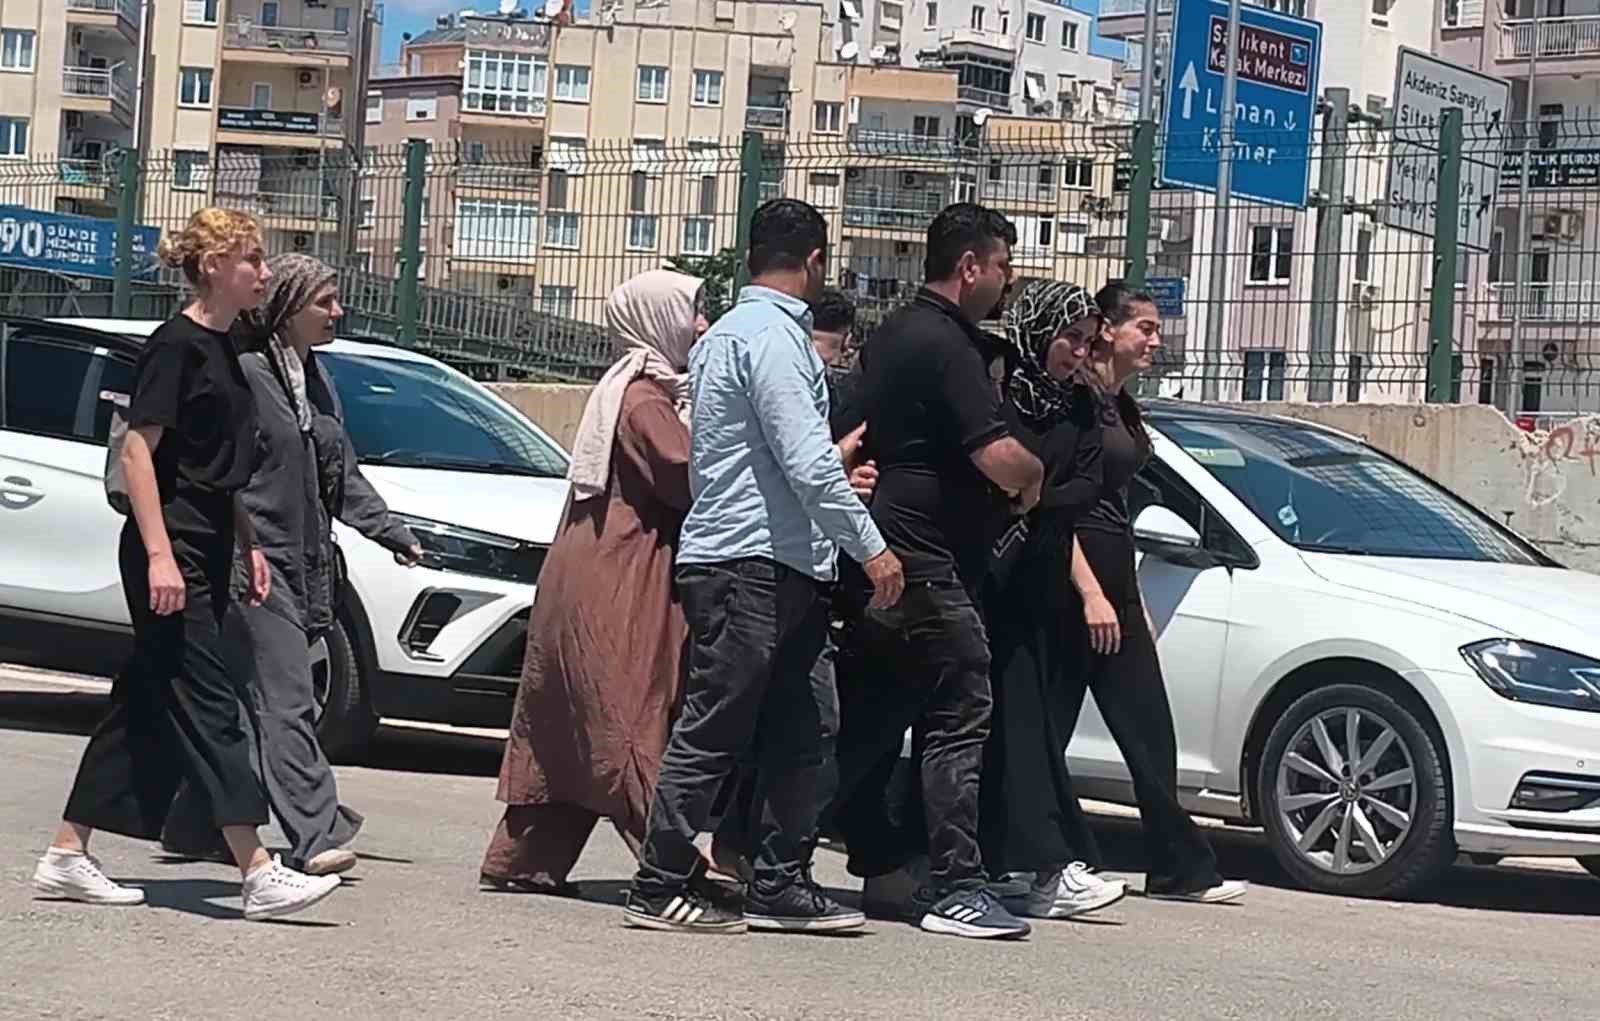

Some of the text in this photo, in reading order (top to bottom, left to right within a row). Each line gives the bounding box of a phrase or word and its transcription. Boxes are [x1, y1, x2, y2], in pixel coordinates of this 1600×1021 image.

[1212, 24, 1286, 60] Salıkent
[1210, 46, 1307, 87] Kaak Merkezi
[1404, 70, 1448, 100] Akdeniz
[1206, 88, 1276, 128] Lman
